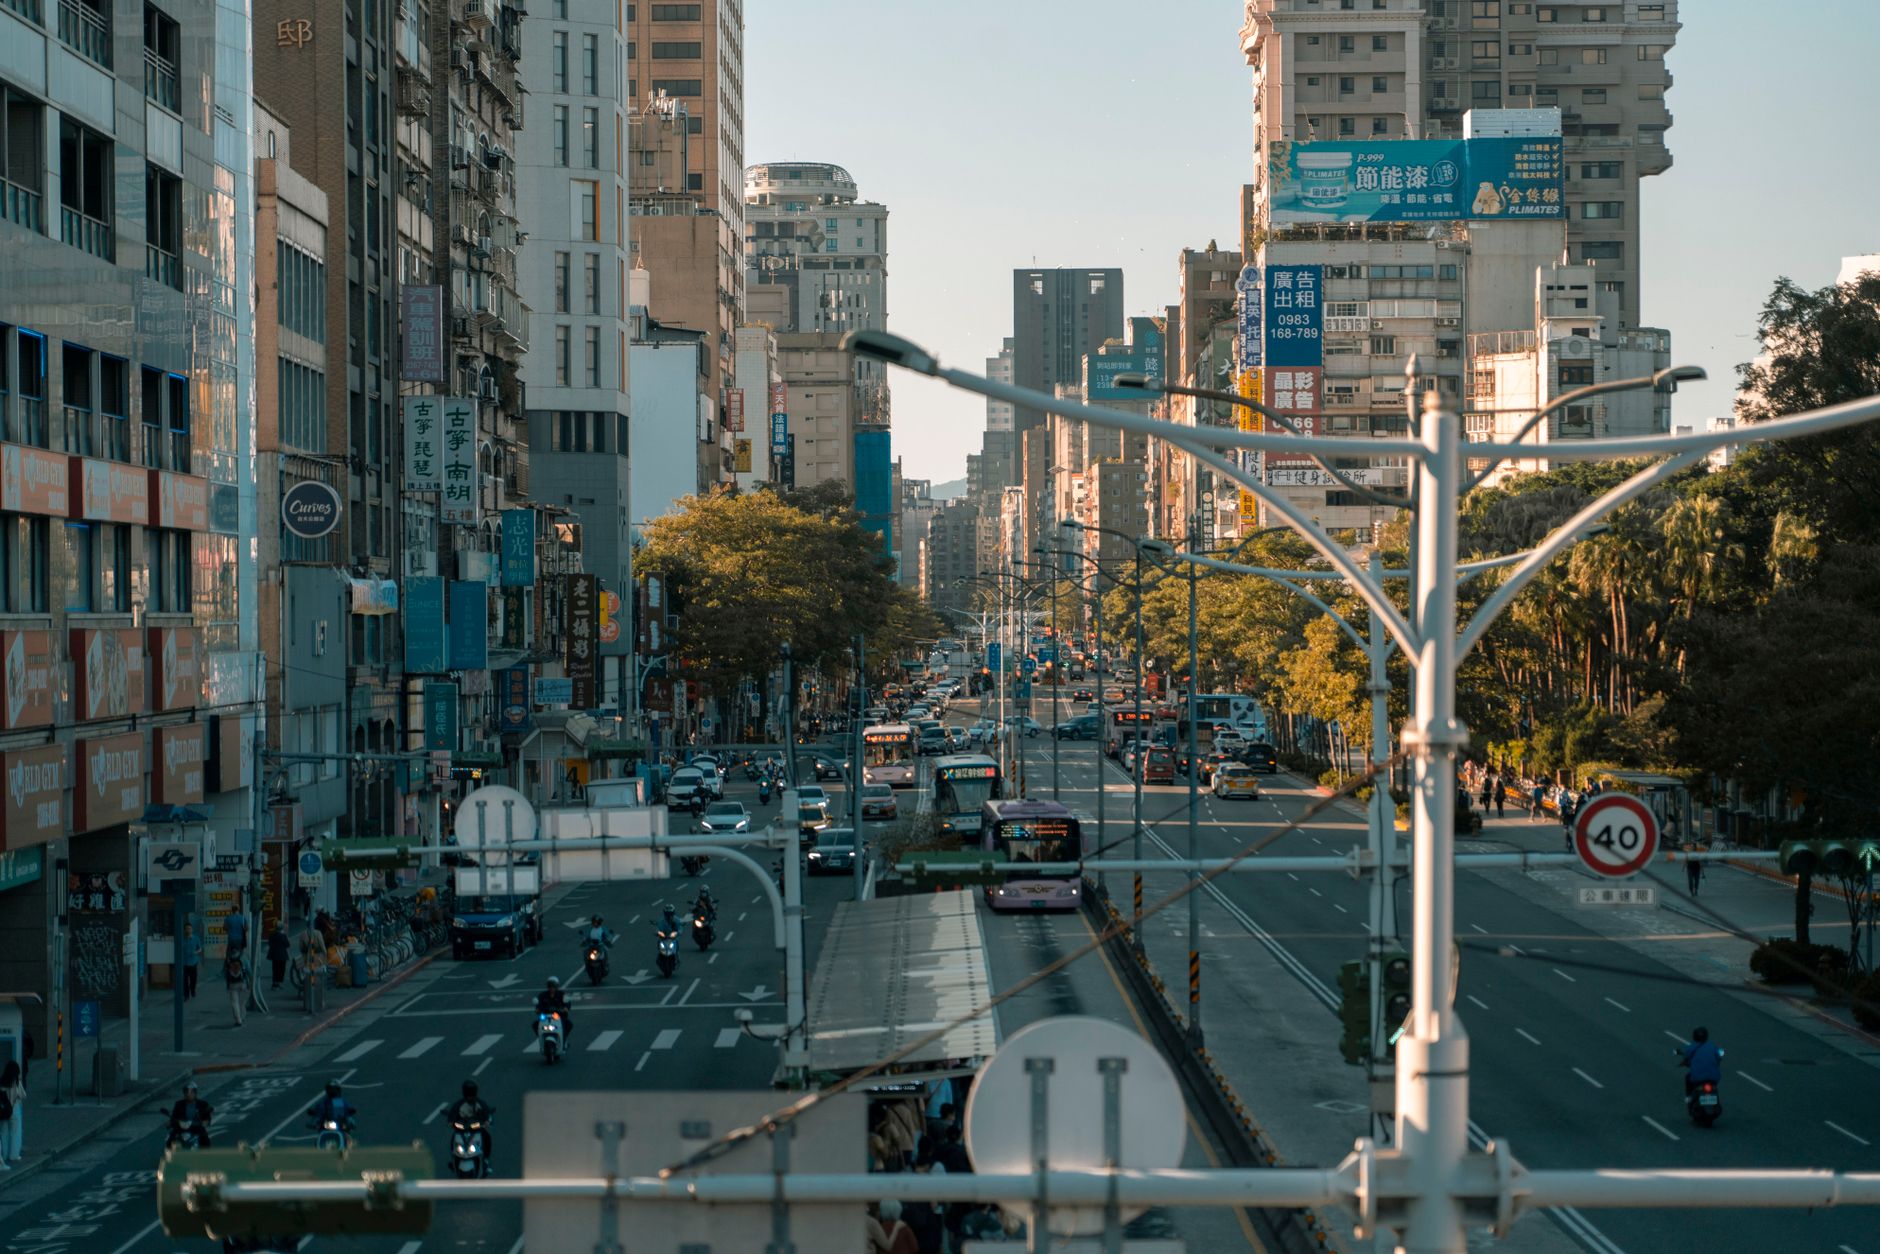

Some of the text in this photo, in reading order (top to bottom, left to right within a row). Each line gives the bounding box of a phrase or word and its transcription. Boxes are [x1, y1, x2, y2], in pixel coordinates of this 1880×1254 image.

[1357, 153, 1385, 163] P-999
[1355, 165, 1428, 191] 節能漆
[1508, 205, 1559, 215] PLIMATES
[1272, 271, 1316, 289] 廣告
[1274, 290, 1316, 308] 出租
[1278, 314, 1310, 326] 0983
[1270, 327, 1318, 339] 168-789
[1274, 371, 1314, 390] 晶彩
[1274, 391, 1314, 409] 廣告
[290, 500, 332, 515] Curves
[507, 515, 528, 556] 志光
[165, 736, 186, 776] WORLD
[91, 745, 140, 799] WORLD GYM
[9, 759, 60, 809] WORLD GYM
[1593, 825, 1639, 851] 40
